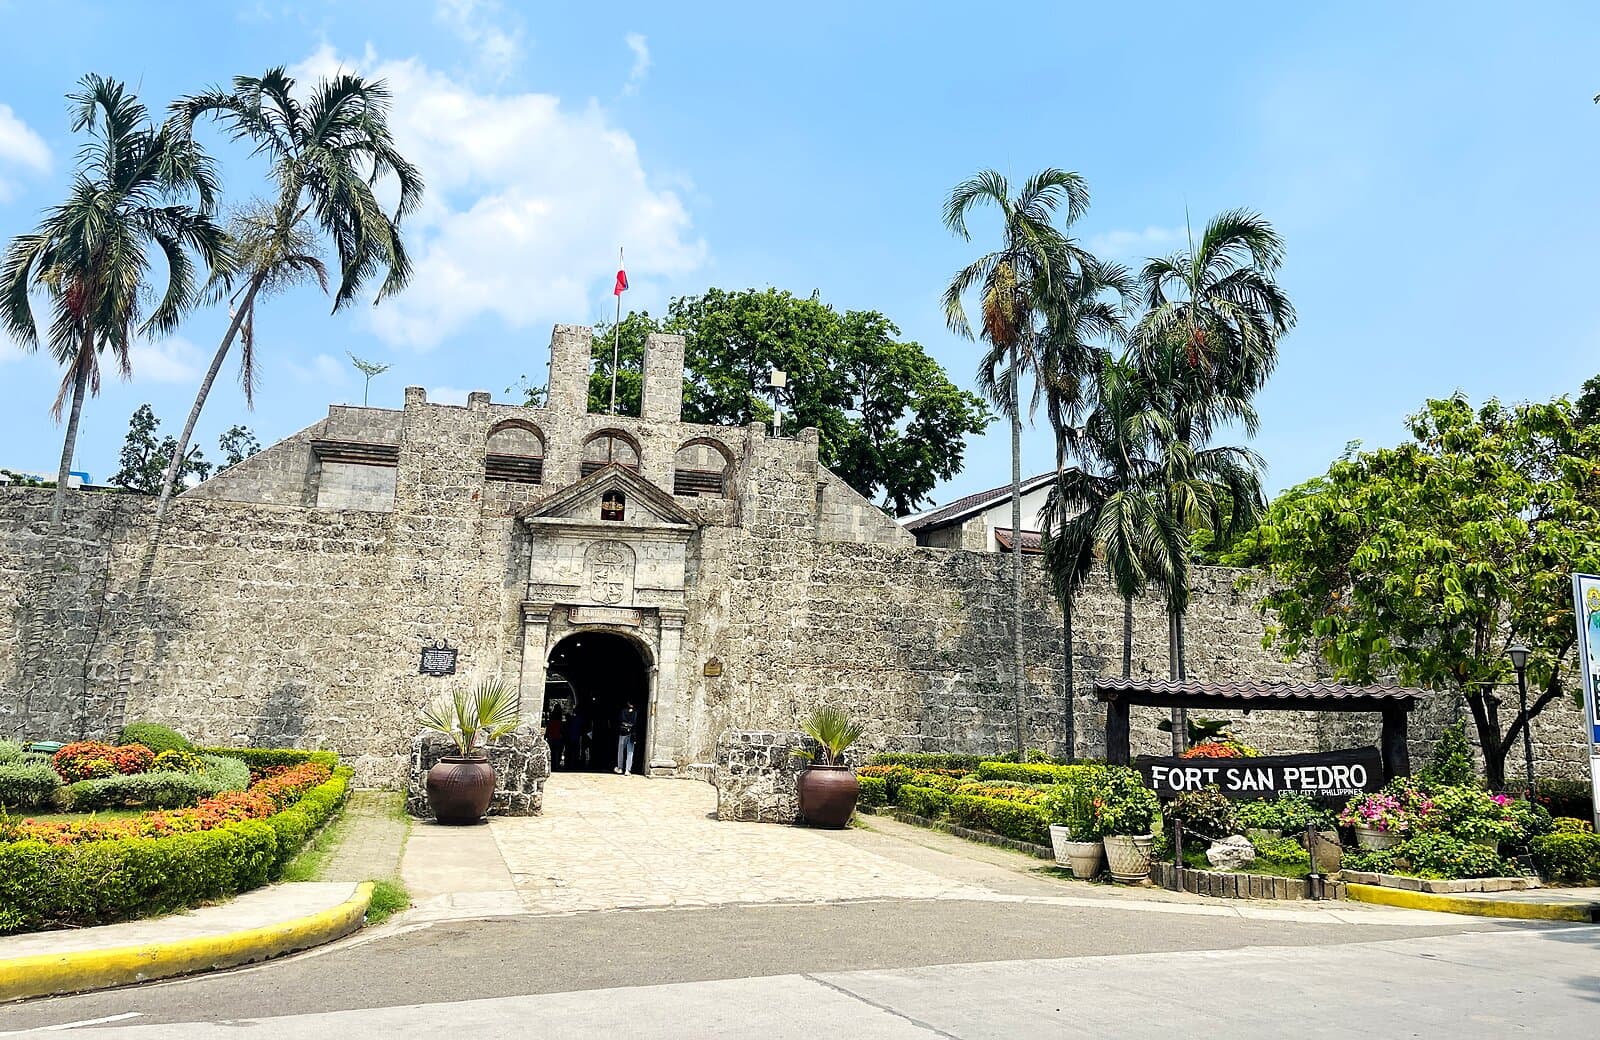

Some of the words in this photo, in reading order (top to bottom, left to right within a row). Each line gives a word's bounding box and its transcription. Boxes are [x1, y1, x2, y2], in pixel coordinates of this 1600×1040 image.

[1151, 766, 1219, 791] FORT
[1226, 768, 1275, 791] SAN
[1283, 764, 1368, 789] PEDRO
[1300, 789, 1317, 797] CITY
[1321, 788, 1363, 797] PHILIPPINES
